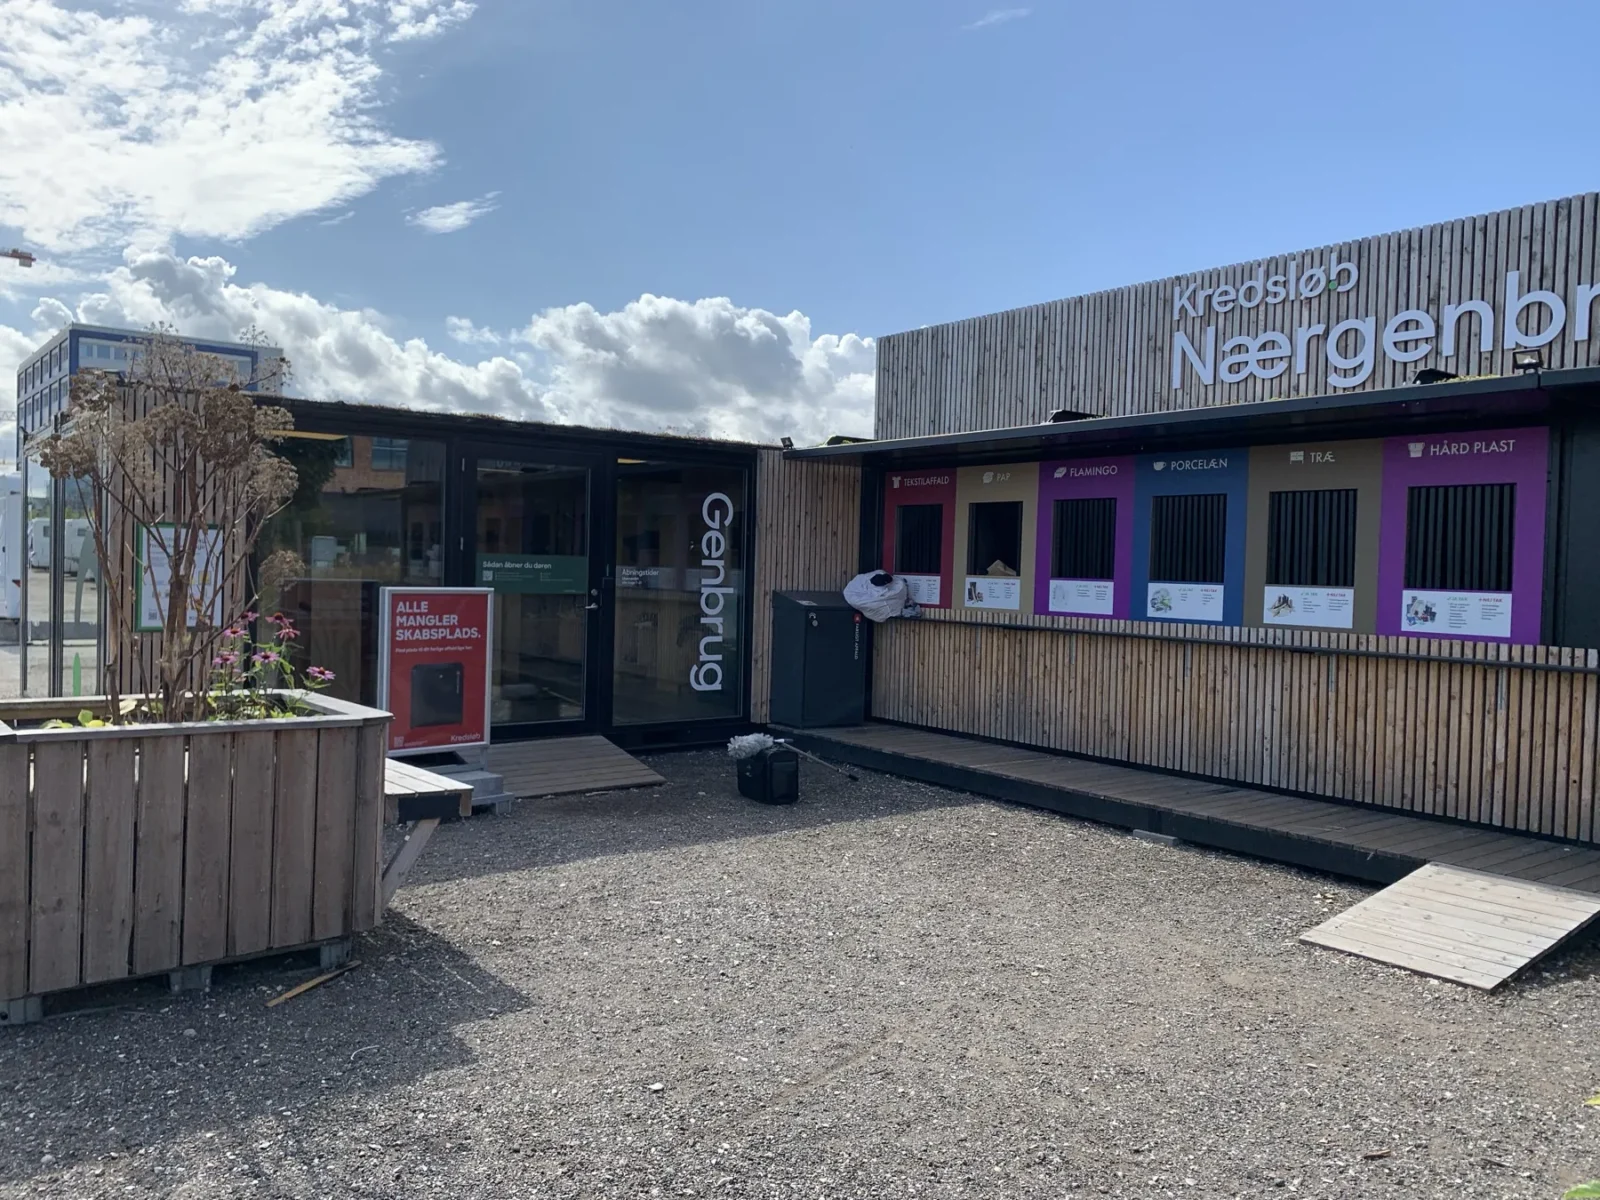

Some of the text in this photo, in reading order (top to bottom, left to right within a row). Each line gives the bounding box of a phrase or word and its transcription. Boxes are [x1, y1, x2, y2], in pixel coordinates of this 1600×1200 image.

[1173, 252, 1359, 320] Kredsløb
[1172, 270, 1600, 390] Nærgenbr
[1430, 439, 1516, 456] HÅRD PLAST
[1170, 458, 1228, 471] PORCELÆN
[1309, 452, 1336, 464] TRÆ
[996, 472, 1011, 482] PAP
[1069, 465, 1118, 477] FLAMINGO
[903, 476, 950, 487] TEKSTILAFFALD
[689, 492, 734, 691] Genbrug
[396, 601, 428, 613] ALLE
[396, 614, 458, 627] MANGLER
[395, 627, 481, 641] SKABSPLADS.
